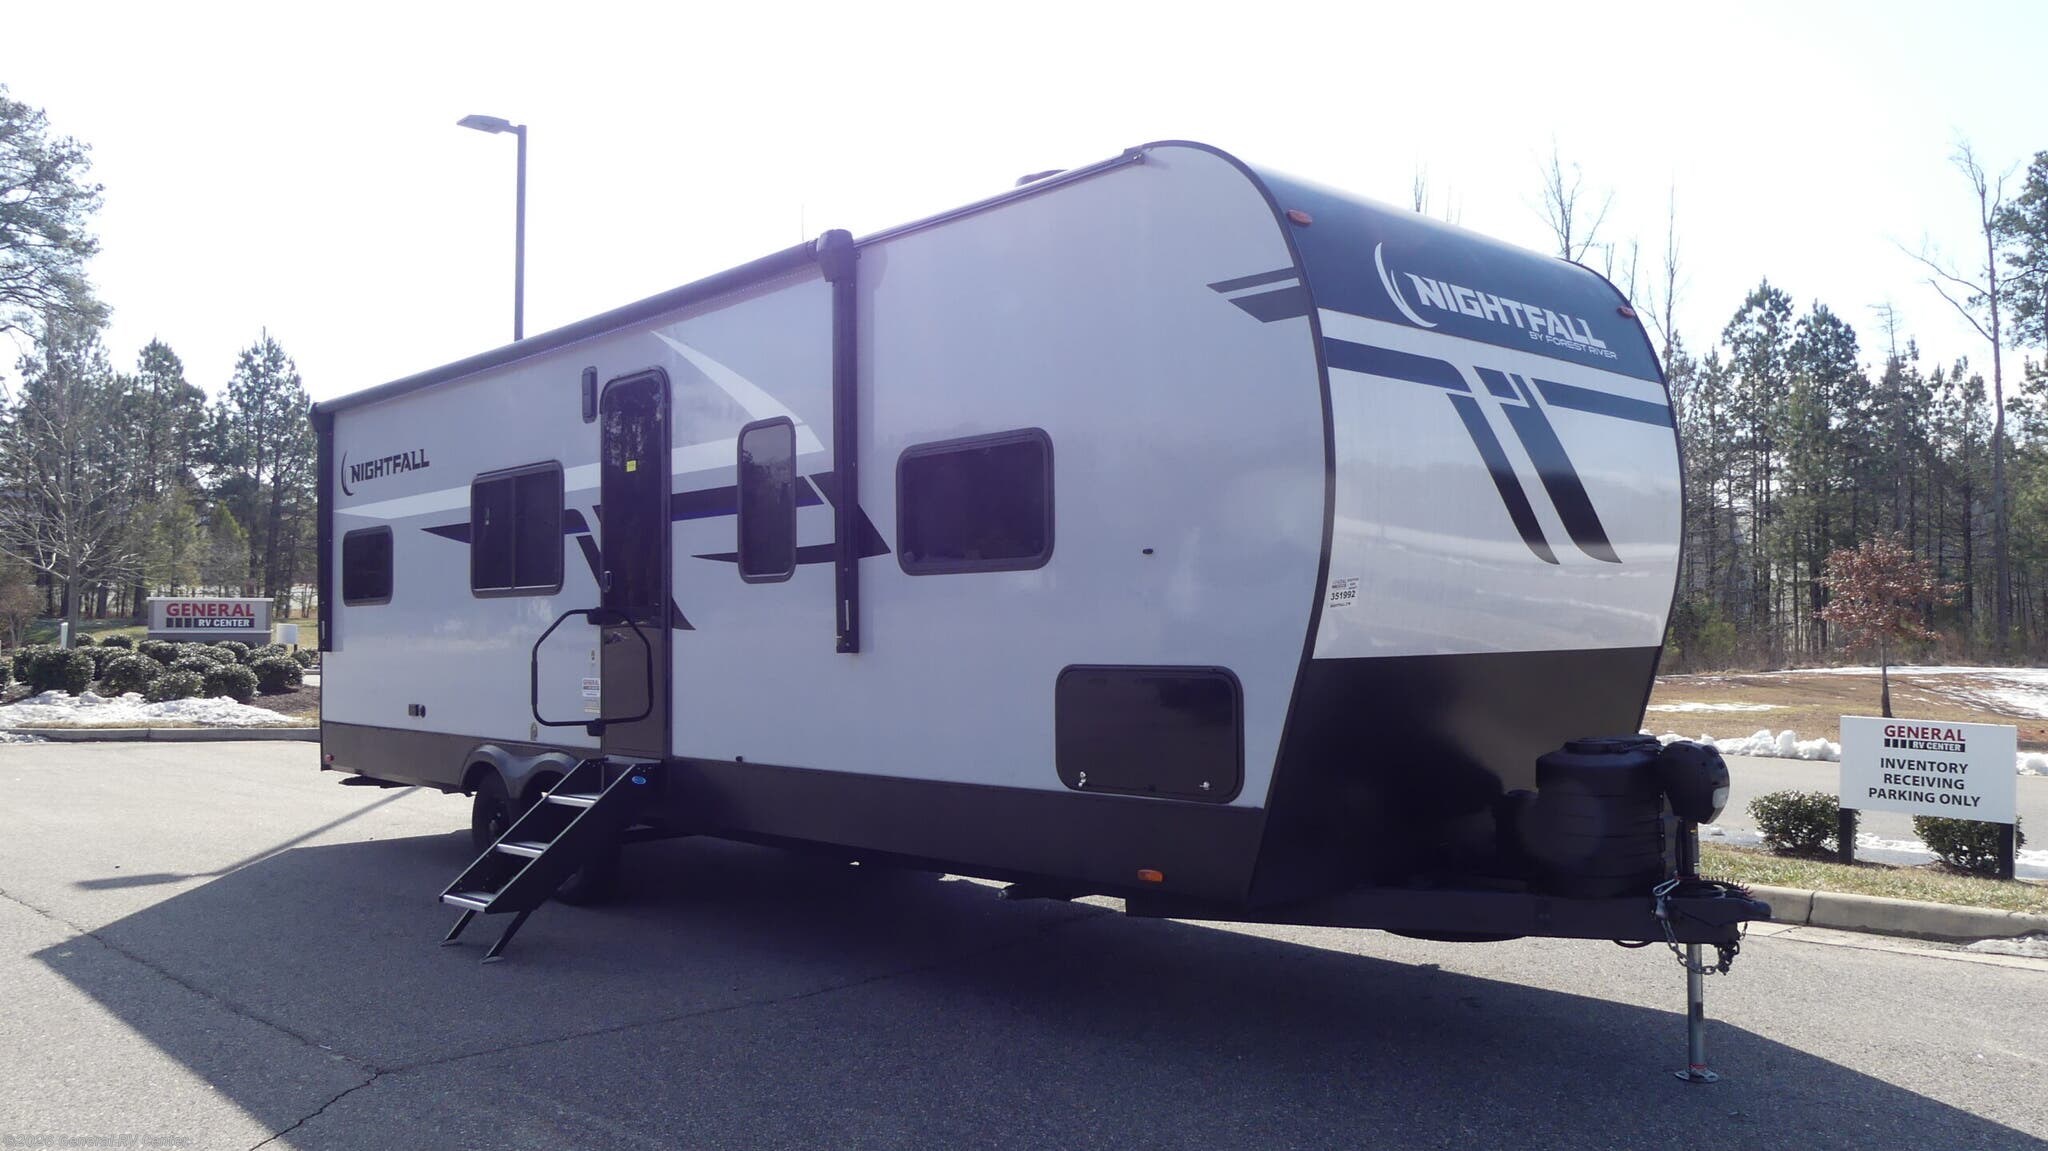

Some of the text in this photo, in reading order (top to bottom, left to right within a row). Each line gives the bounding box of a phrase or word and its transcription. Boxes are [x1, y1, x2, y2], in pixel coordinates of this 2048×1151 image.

[1404, 271, 1606, 349] NIGHTFALL
[1529, 331, 1618, 360] BY FOREST RIVER
[349, 448, 430, 483] NIGHTFALL
[1330, 590, 1356, 600] 351992
[166, 603, 255, 617] GENERAL
[198, 619, 250, 627] RV CENTER
[1884, 725, 1966, 742] GENERAL
[1912, 741, 1961, 751] RV CENTER
[1880, 758, 1968, 774] INVENTORY
[1884, 773, 1965, 790] RECEIVING
[1868, 787, 1981, 807] PARKING ONLY
